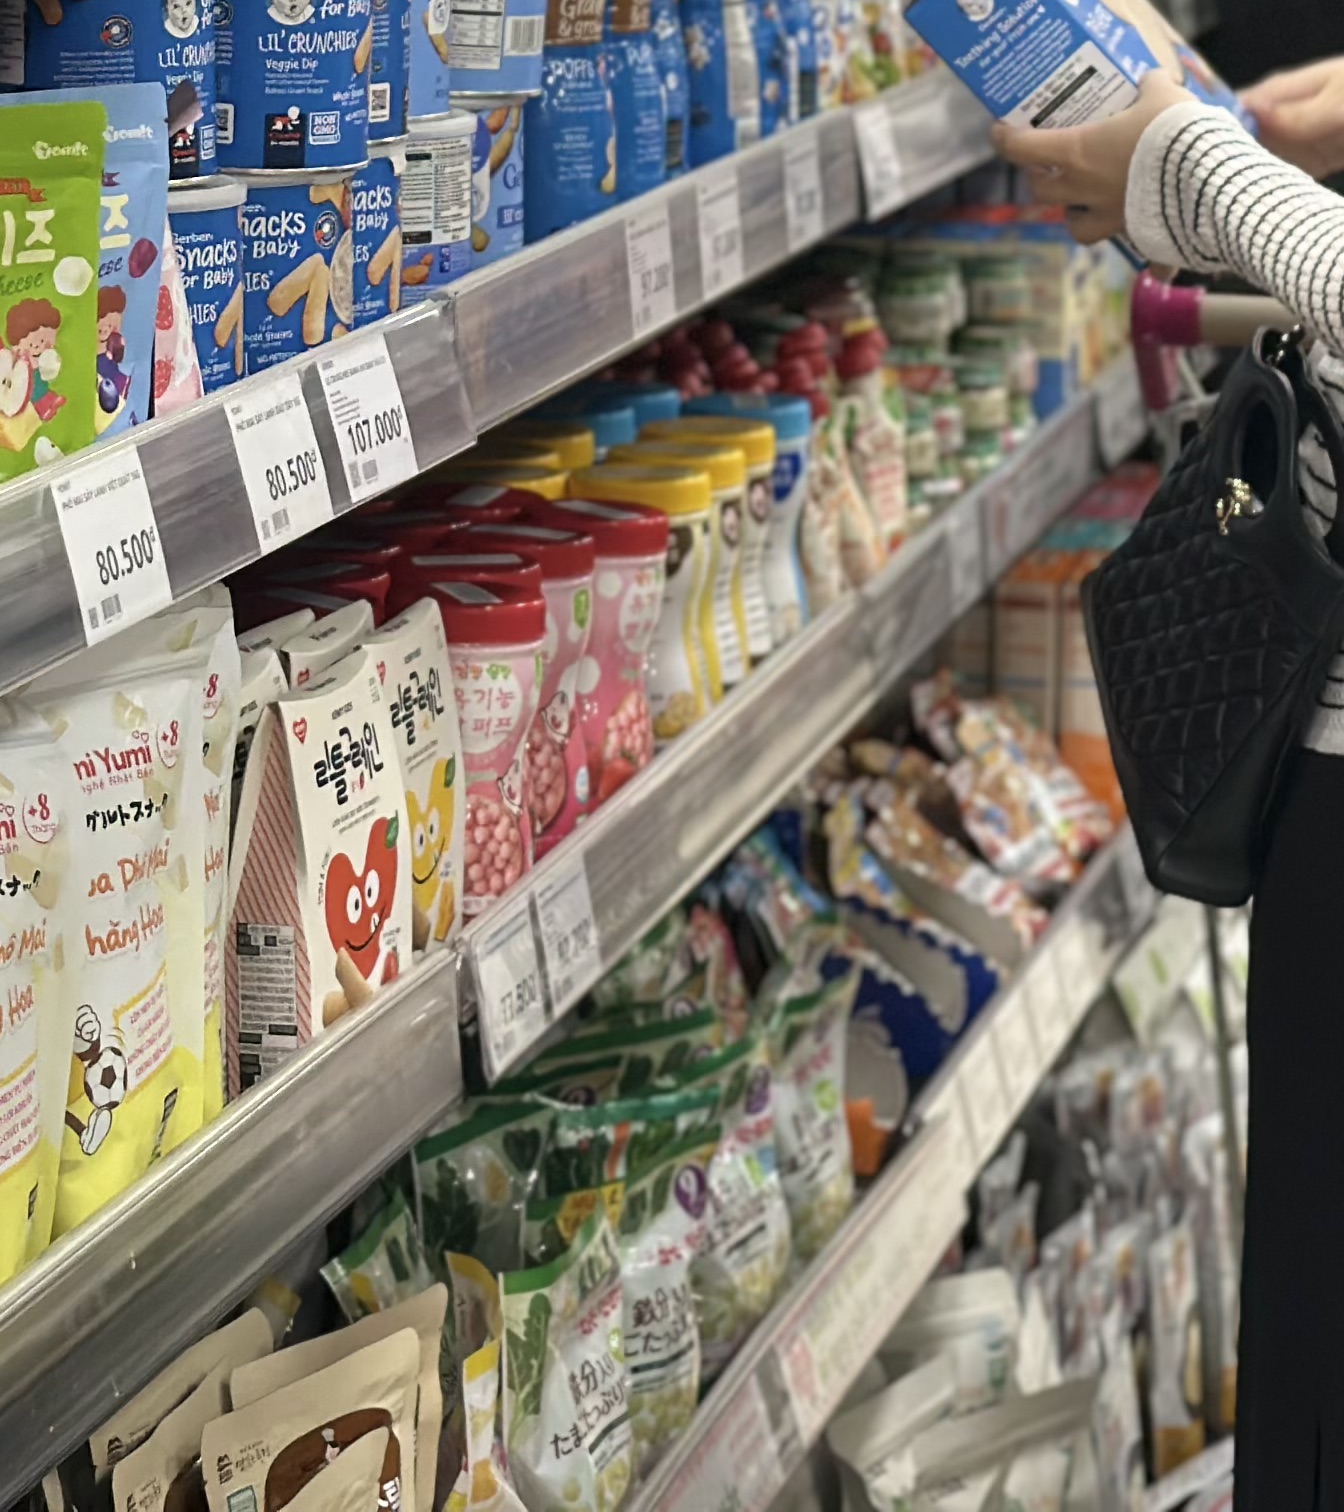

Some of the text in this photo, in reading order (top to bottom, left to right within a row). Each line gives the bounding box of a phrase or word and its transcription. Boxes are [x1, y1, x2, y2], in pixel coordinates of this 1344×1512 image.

[320, 0, 344, 19] for
[258, 29, 357, 54] LIL' CRUNCHIES
[954, 30, 1002, 69] Teething
[265, 58, 319, 72] Veggie Dip
[314, 115, 336, 125] NON
[353, 185, 392, 210] acks
[100, 194, 132, 250] 즈
[242, 210, 307, 238] nacks
[356, 211, 389, 232] Baby
[175, 238, 237, 271] Snacks
[253, 238, 301, 259] Baby
[204, 268, 234, 290] Baby
[347, 405, 402, 455] 107.000đ
[265, 449, 317, 500] 80.500đ
[96, 526, 155, 585] 80.500đ
[96, 742, 152, 774] Yumi
[19, 920, 47, 958] Mai
[85, 921, 140, 958] hăng
[8, 985, 34, 1026] Hoa
